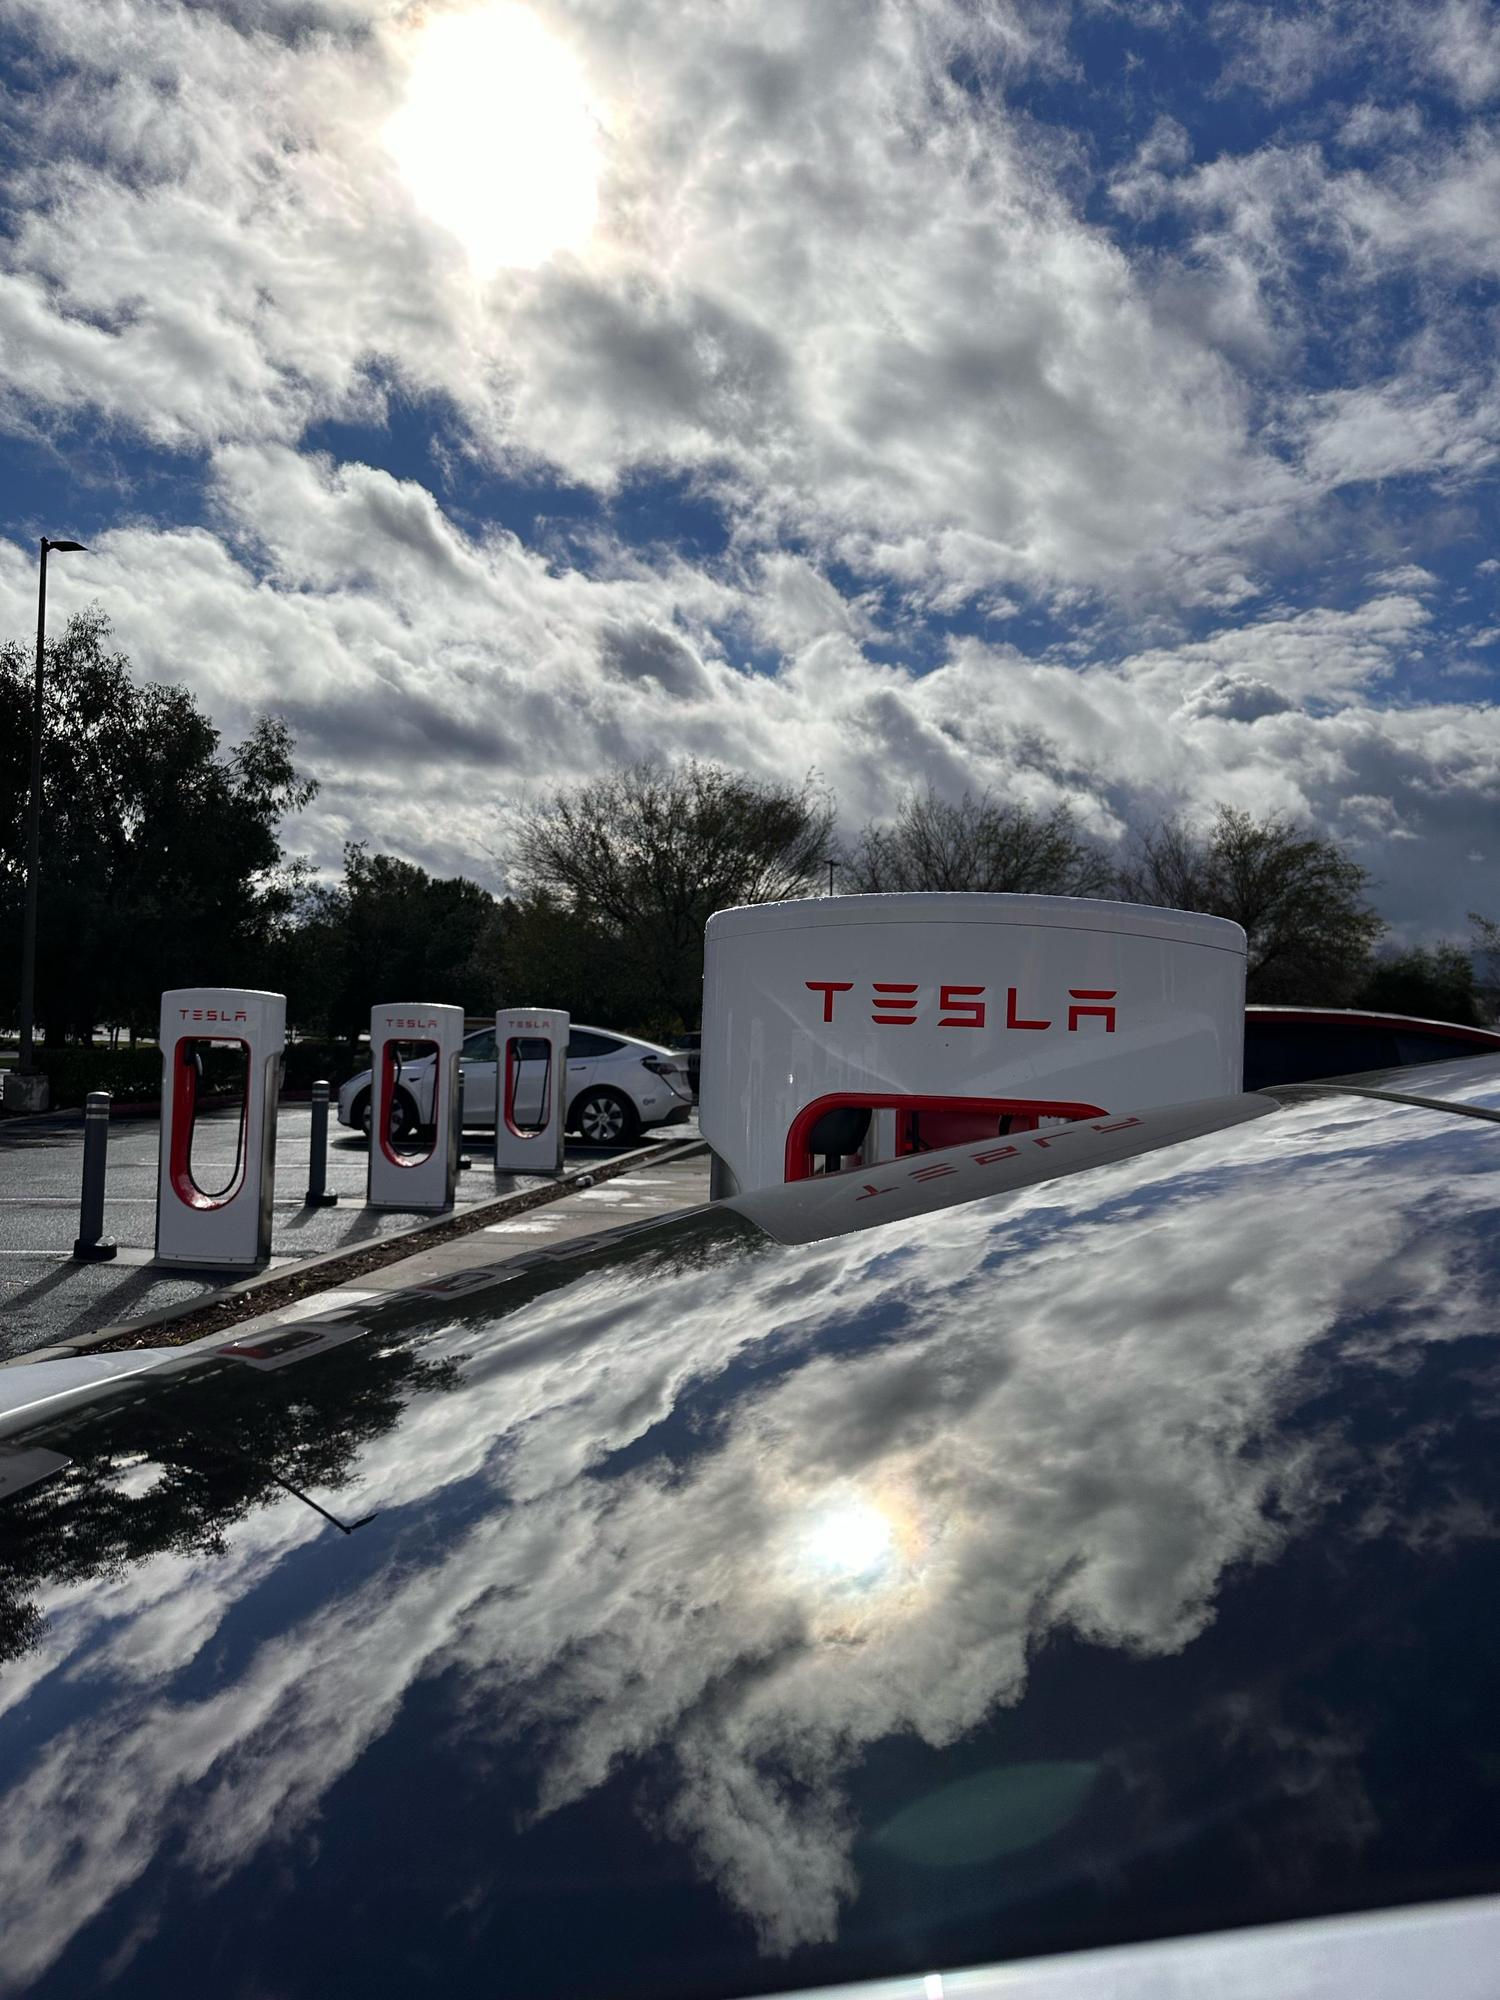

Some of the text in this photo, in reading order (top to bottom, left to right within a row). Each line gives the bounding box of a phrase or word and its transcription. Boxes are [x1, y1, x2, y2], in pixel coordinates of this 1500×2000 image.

[805, 981, 1118, 1033] TESLA
[179, 1009, 247, 1022] TESLA
[385, 1018, 438, 1028] TESLA
[508, 1020, 550, 1029] TESLA
